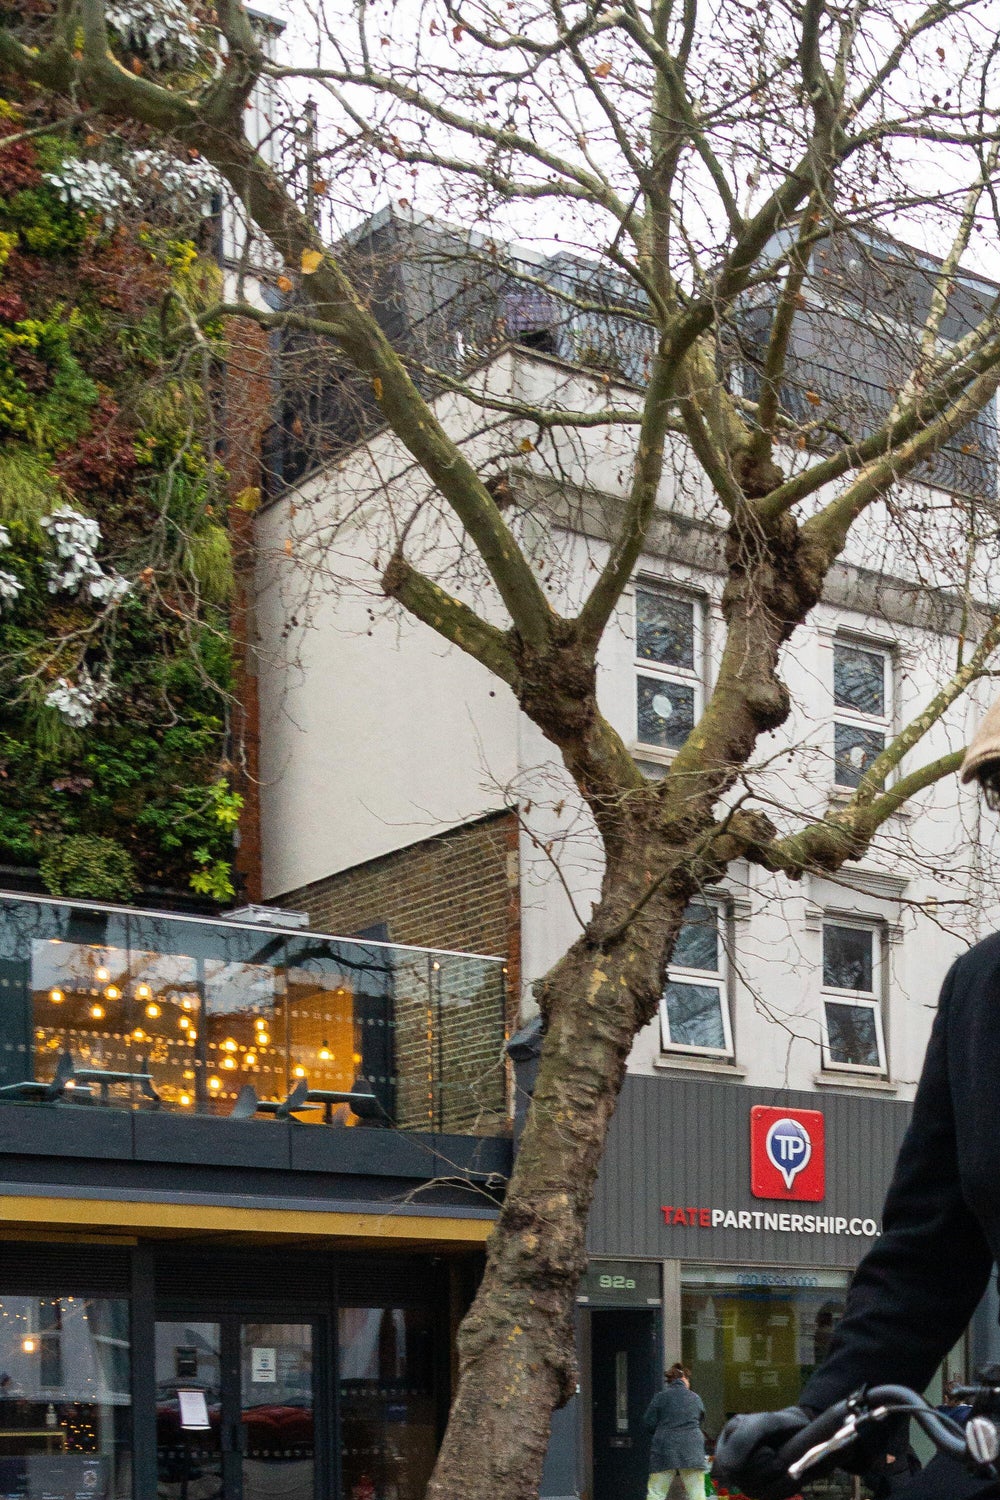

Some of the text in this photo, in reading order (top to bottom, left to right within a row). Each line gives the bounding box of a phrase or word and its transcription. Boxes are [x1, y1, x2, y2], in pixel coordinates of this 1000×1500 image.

[775, 1135, 805, 1160] TP
[661, 1205, 882, 1237] TATEPARTNERSHIP.CO.
[599, 1274, 636, 1289] 92a
